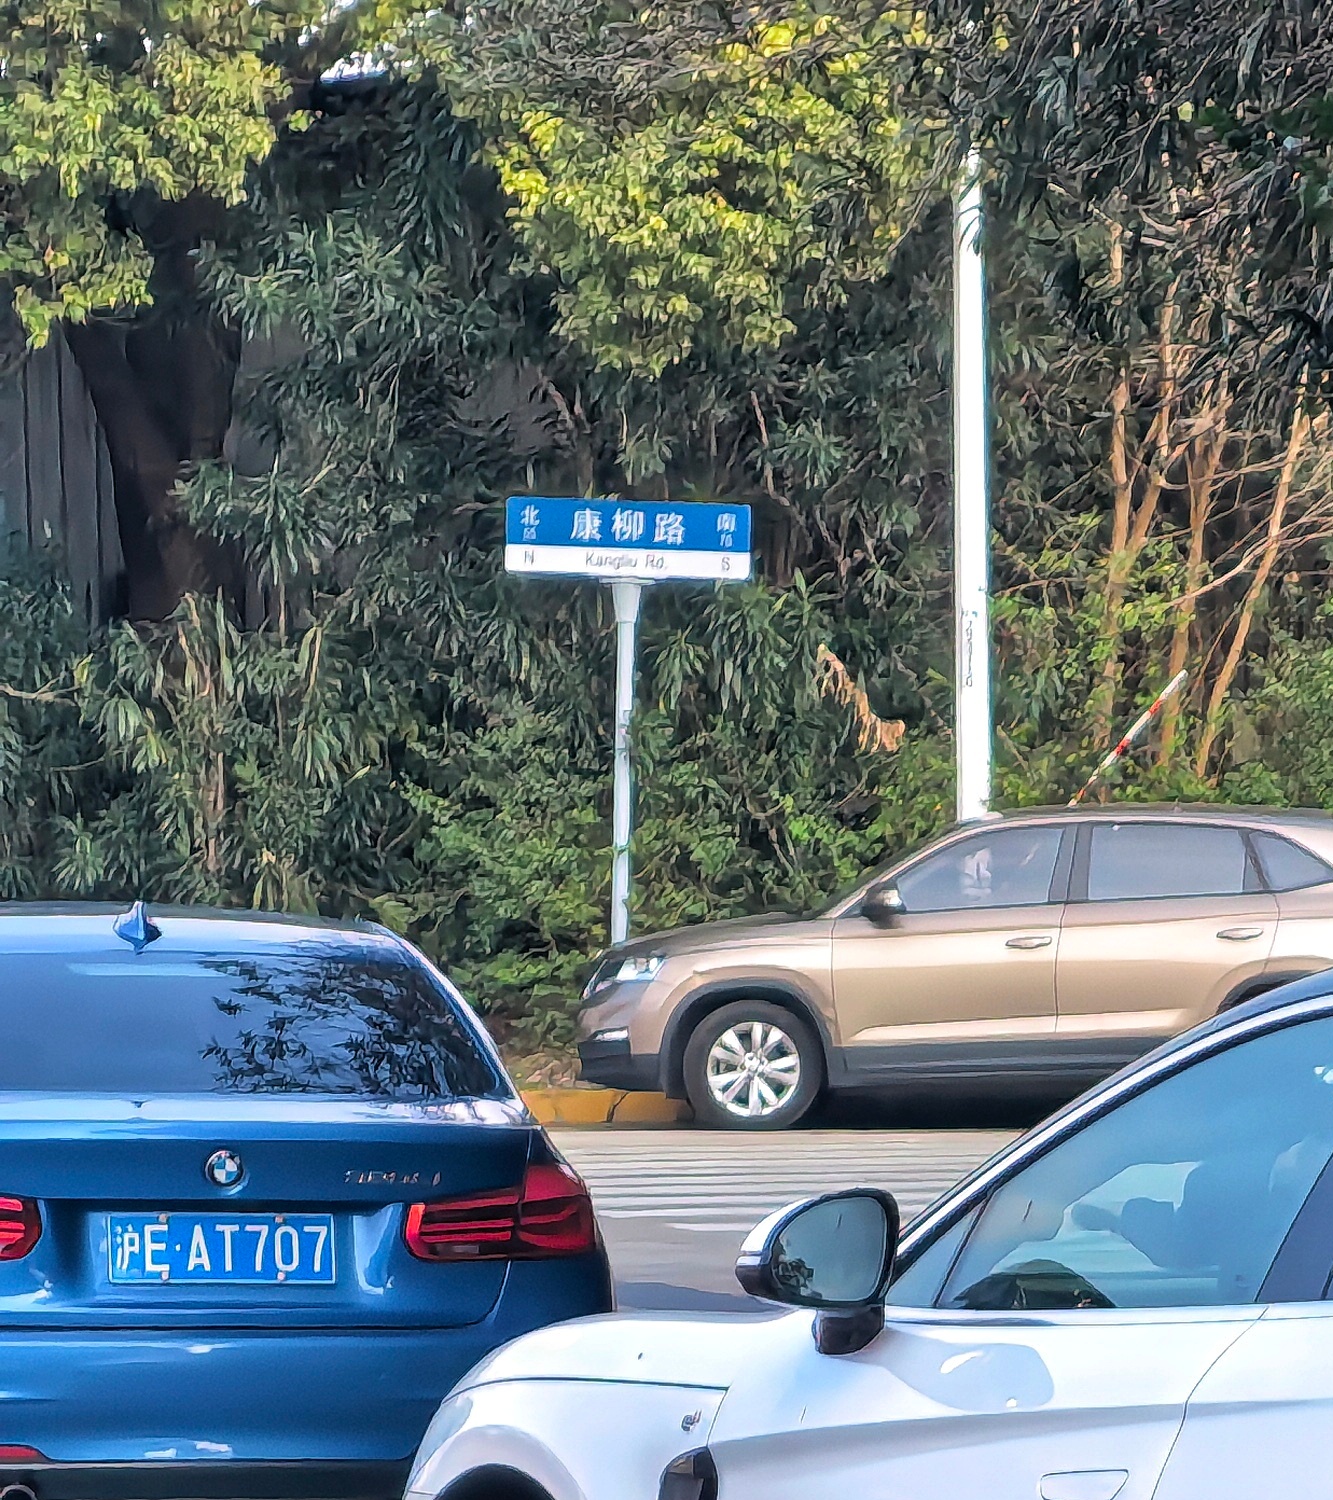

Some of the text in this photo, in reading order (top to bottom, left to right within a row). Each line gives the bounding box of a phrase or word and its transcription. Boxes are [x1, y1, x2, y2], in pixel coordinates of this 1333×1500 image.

[520, 504, 540, 526] 北
[571, 507, 686, 546] 康柳路
[721, 556, 731, 571] S
